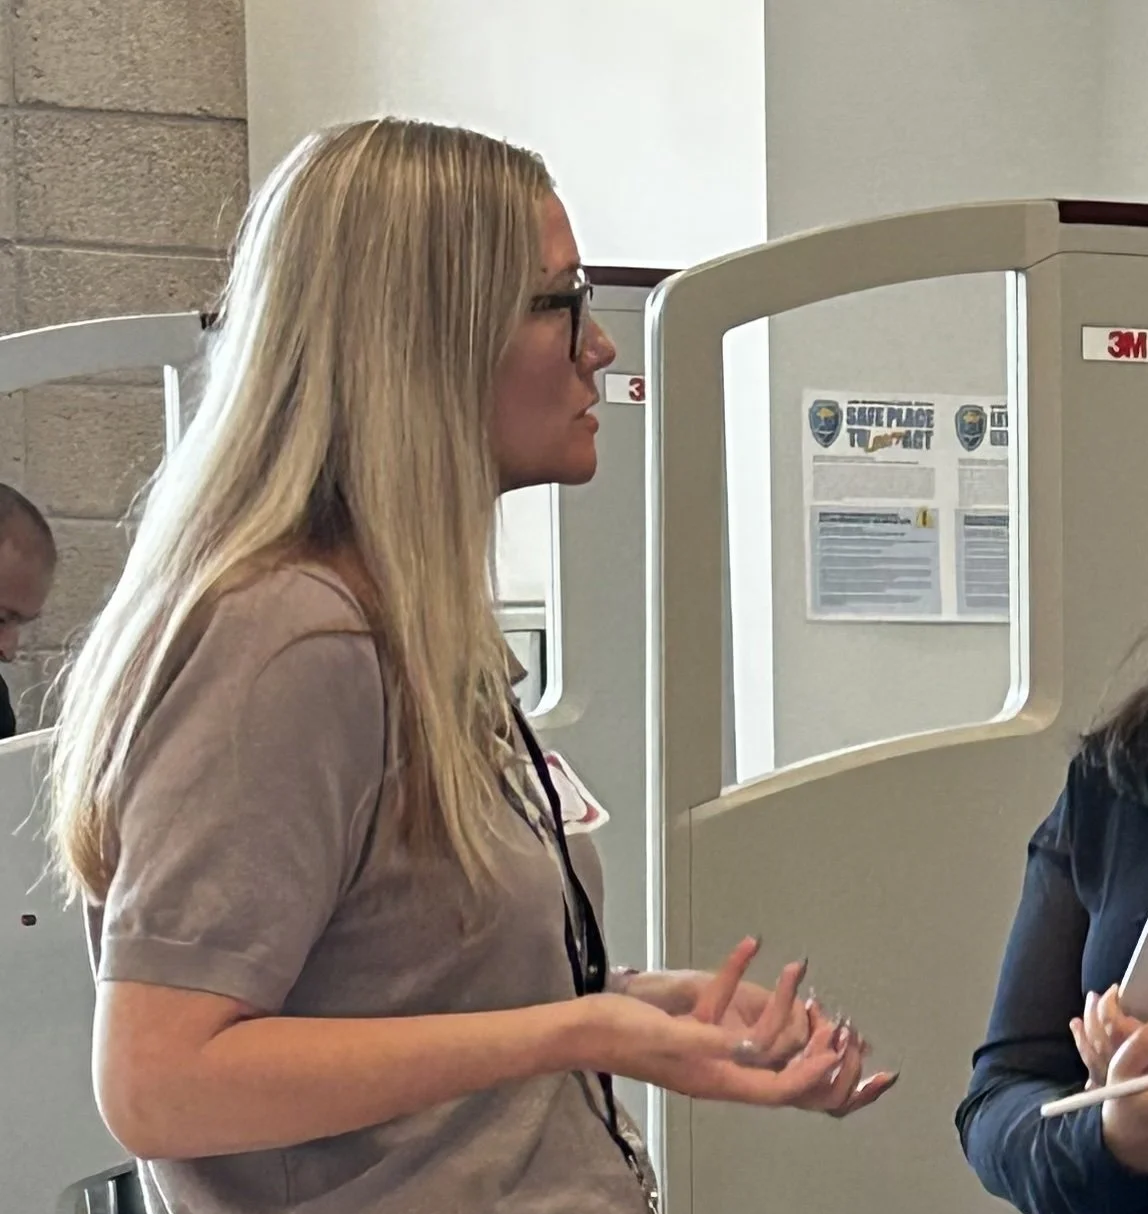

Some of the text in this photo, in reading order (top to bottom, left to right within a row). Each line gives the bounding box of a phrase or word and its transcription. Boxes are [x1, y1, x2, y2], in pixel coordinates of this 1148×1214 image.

[1108, 331, 1147, 359] 3M
[629, 377, 646, 402] 3
[846, 406, 934, 429] SAFE PLACE
